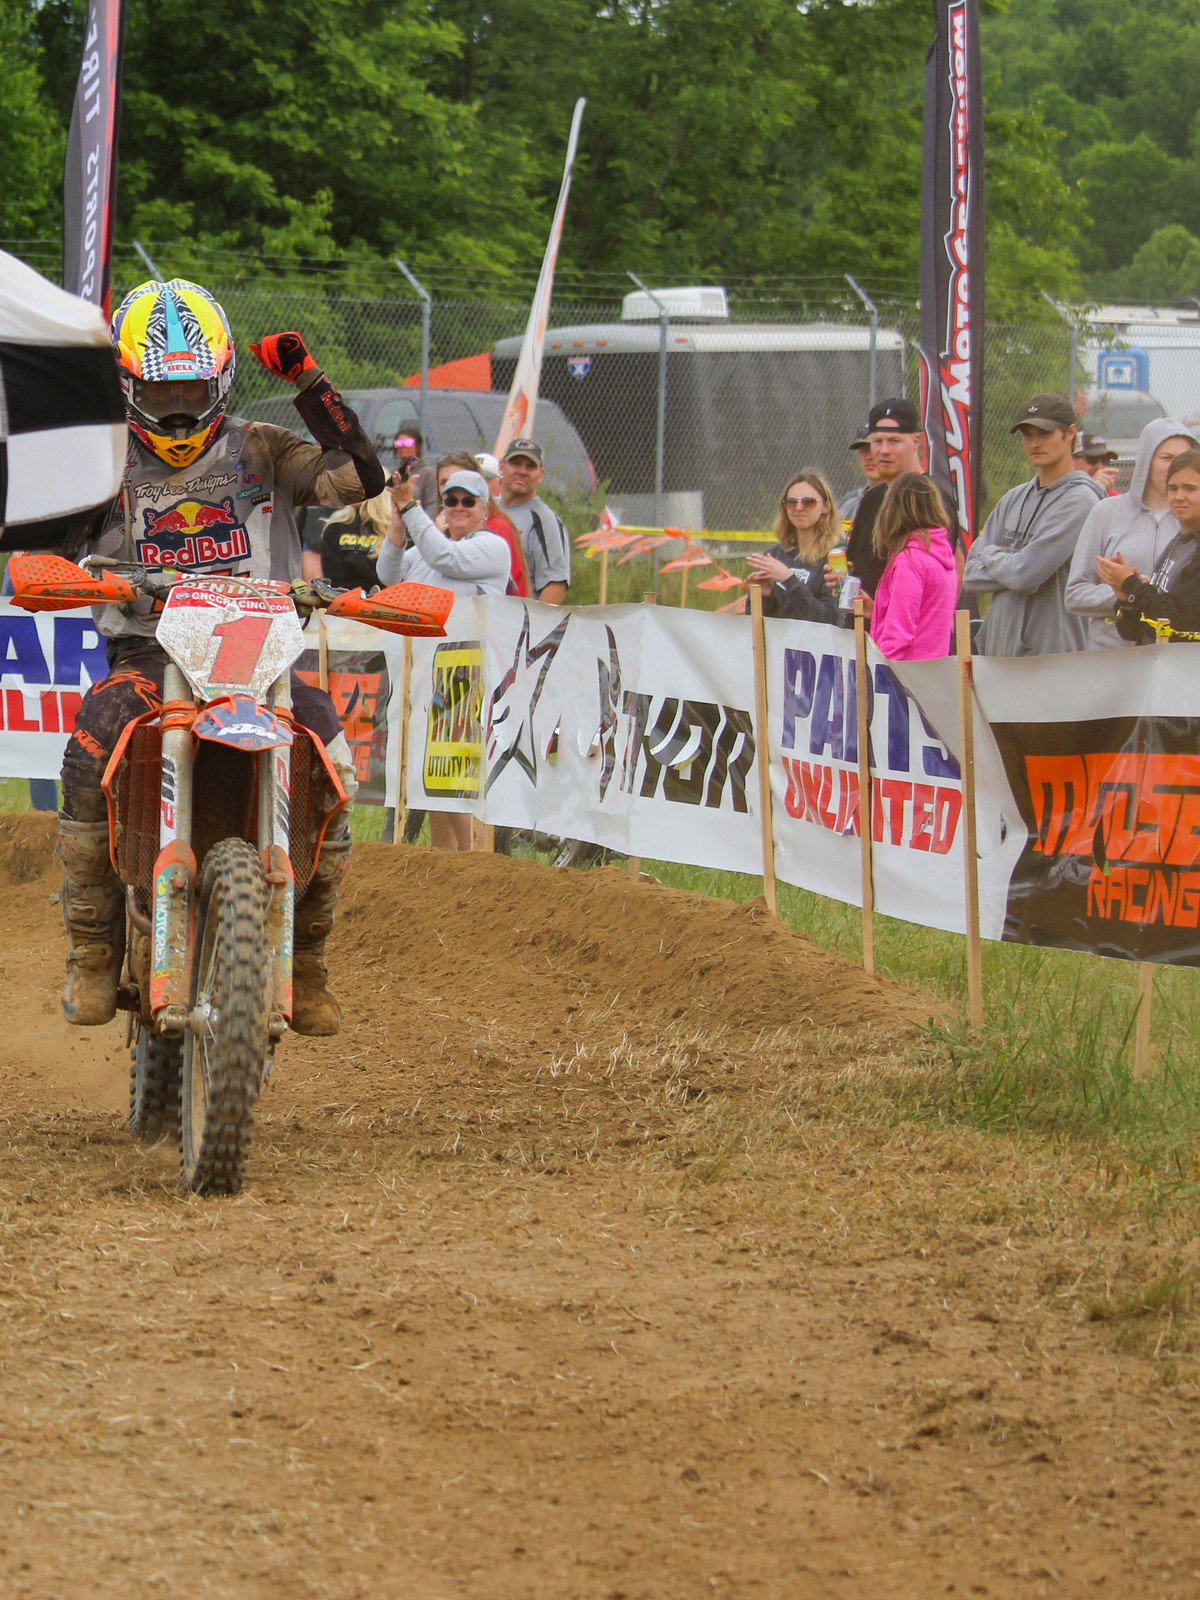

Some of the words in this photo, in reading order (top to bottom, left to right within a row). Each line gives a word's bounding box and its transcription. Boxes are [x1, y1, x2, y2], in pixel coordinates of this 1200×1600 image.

[134, 482, 161, 503] Troy
[162, 486, 186, 496] Lee
[186, 474, 238, 494] Designs
[141, 537, 196, 568] Red
[196, 528, 248, 564] Bull
[208, 616, 273, 685] 1
[217, 723, 277, 739] KTM
[1086, 865, 1200, 929] RACING
